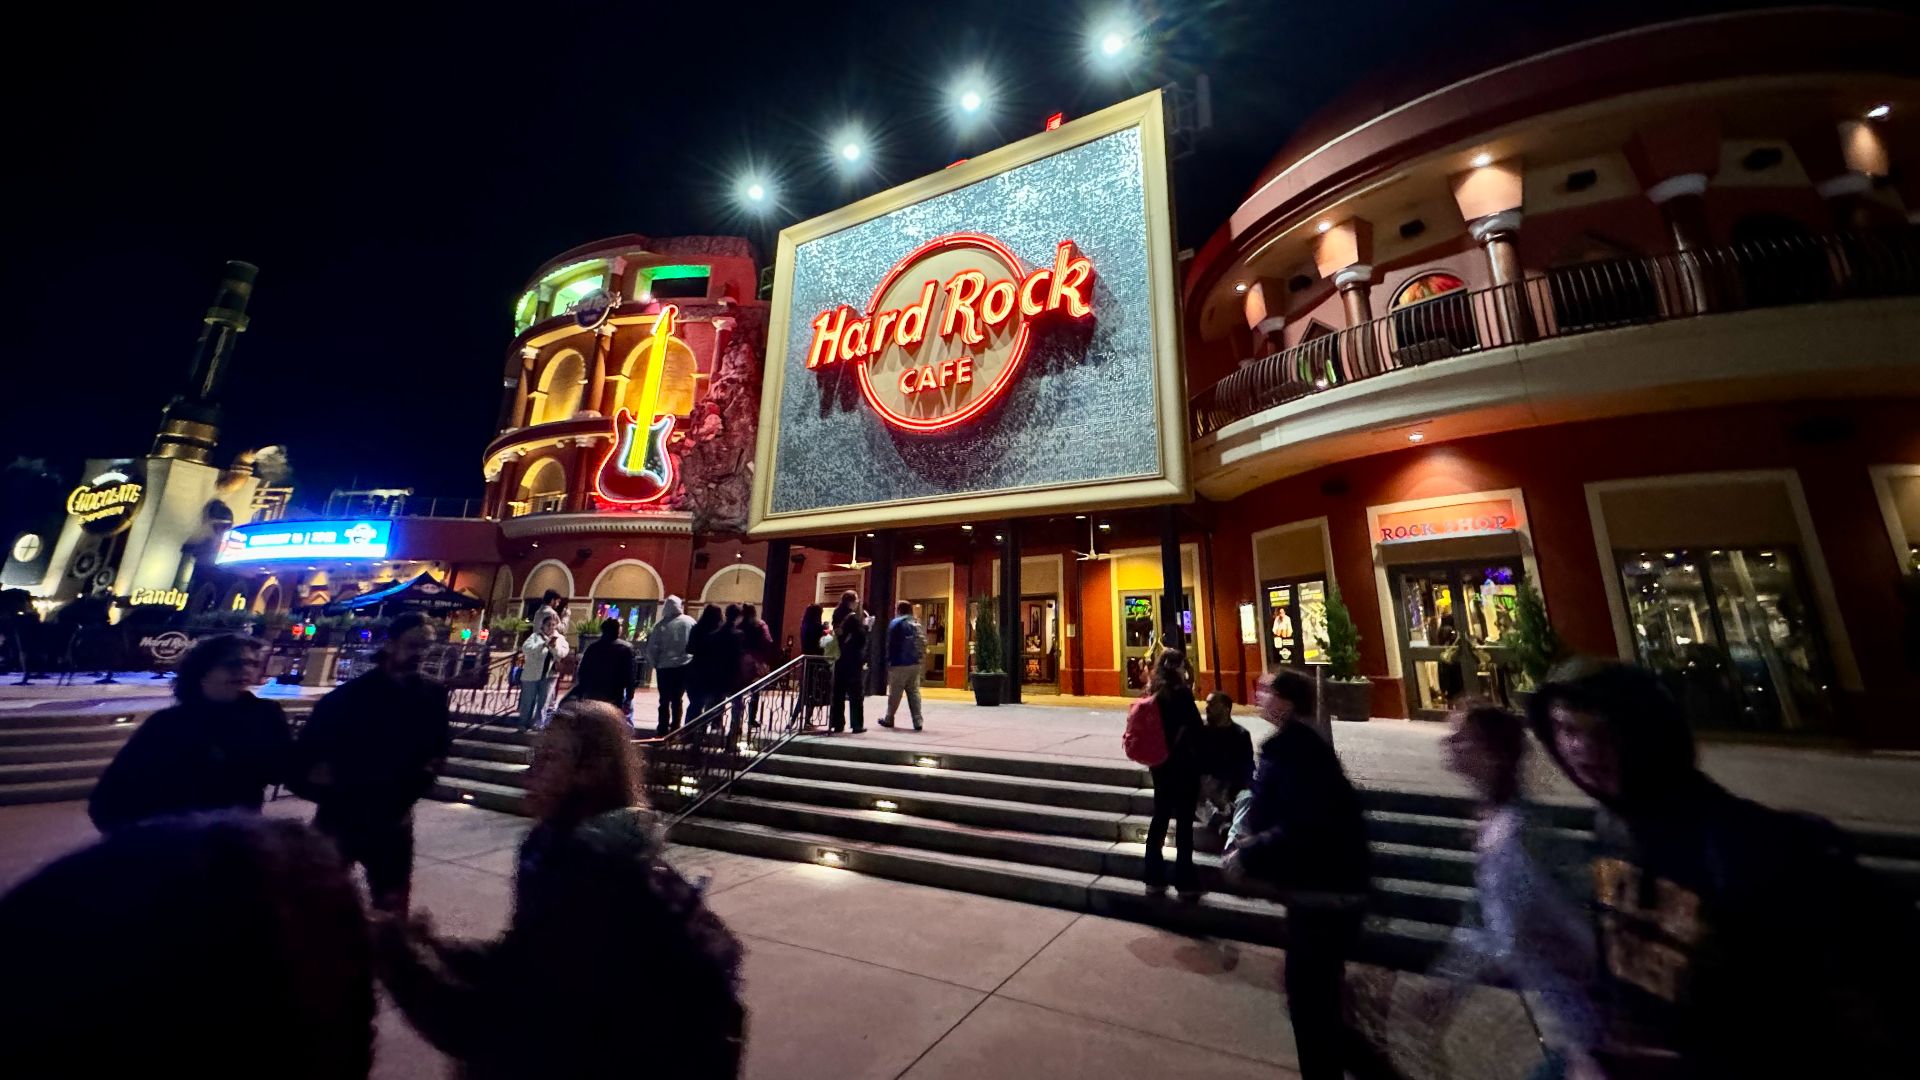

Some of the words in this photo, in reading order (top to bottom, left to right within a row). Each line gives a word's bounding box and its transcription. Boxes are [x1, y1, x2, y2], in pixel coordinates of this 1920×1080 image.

[806, 280, 938, 369] Hard
[940, 239, 1094, 345] Rock
[898, 357, 973, 394] CAFE
[1380, 522, 1437, 541] ROCK
[1444, 515, 1508, 535] SHOP
[130, 587, 189, 611] Candy
